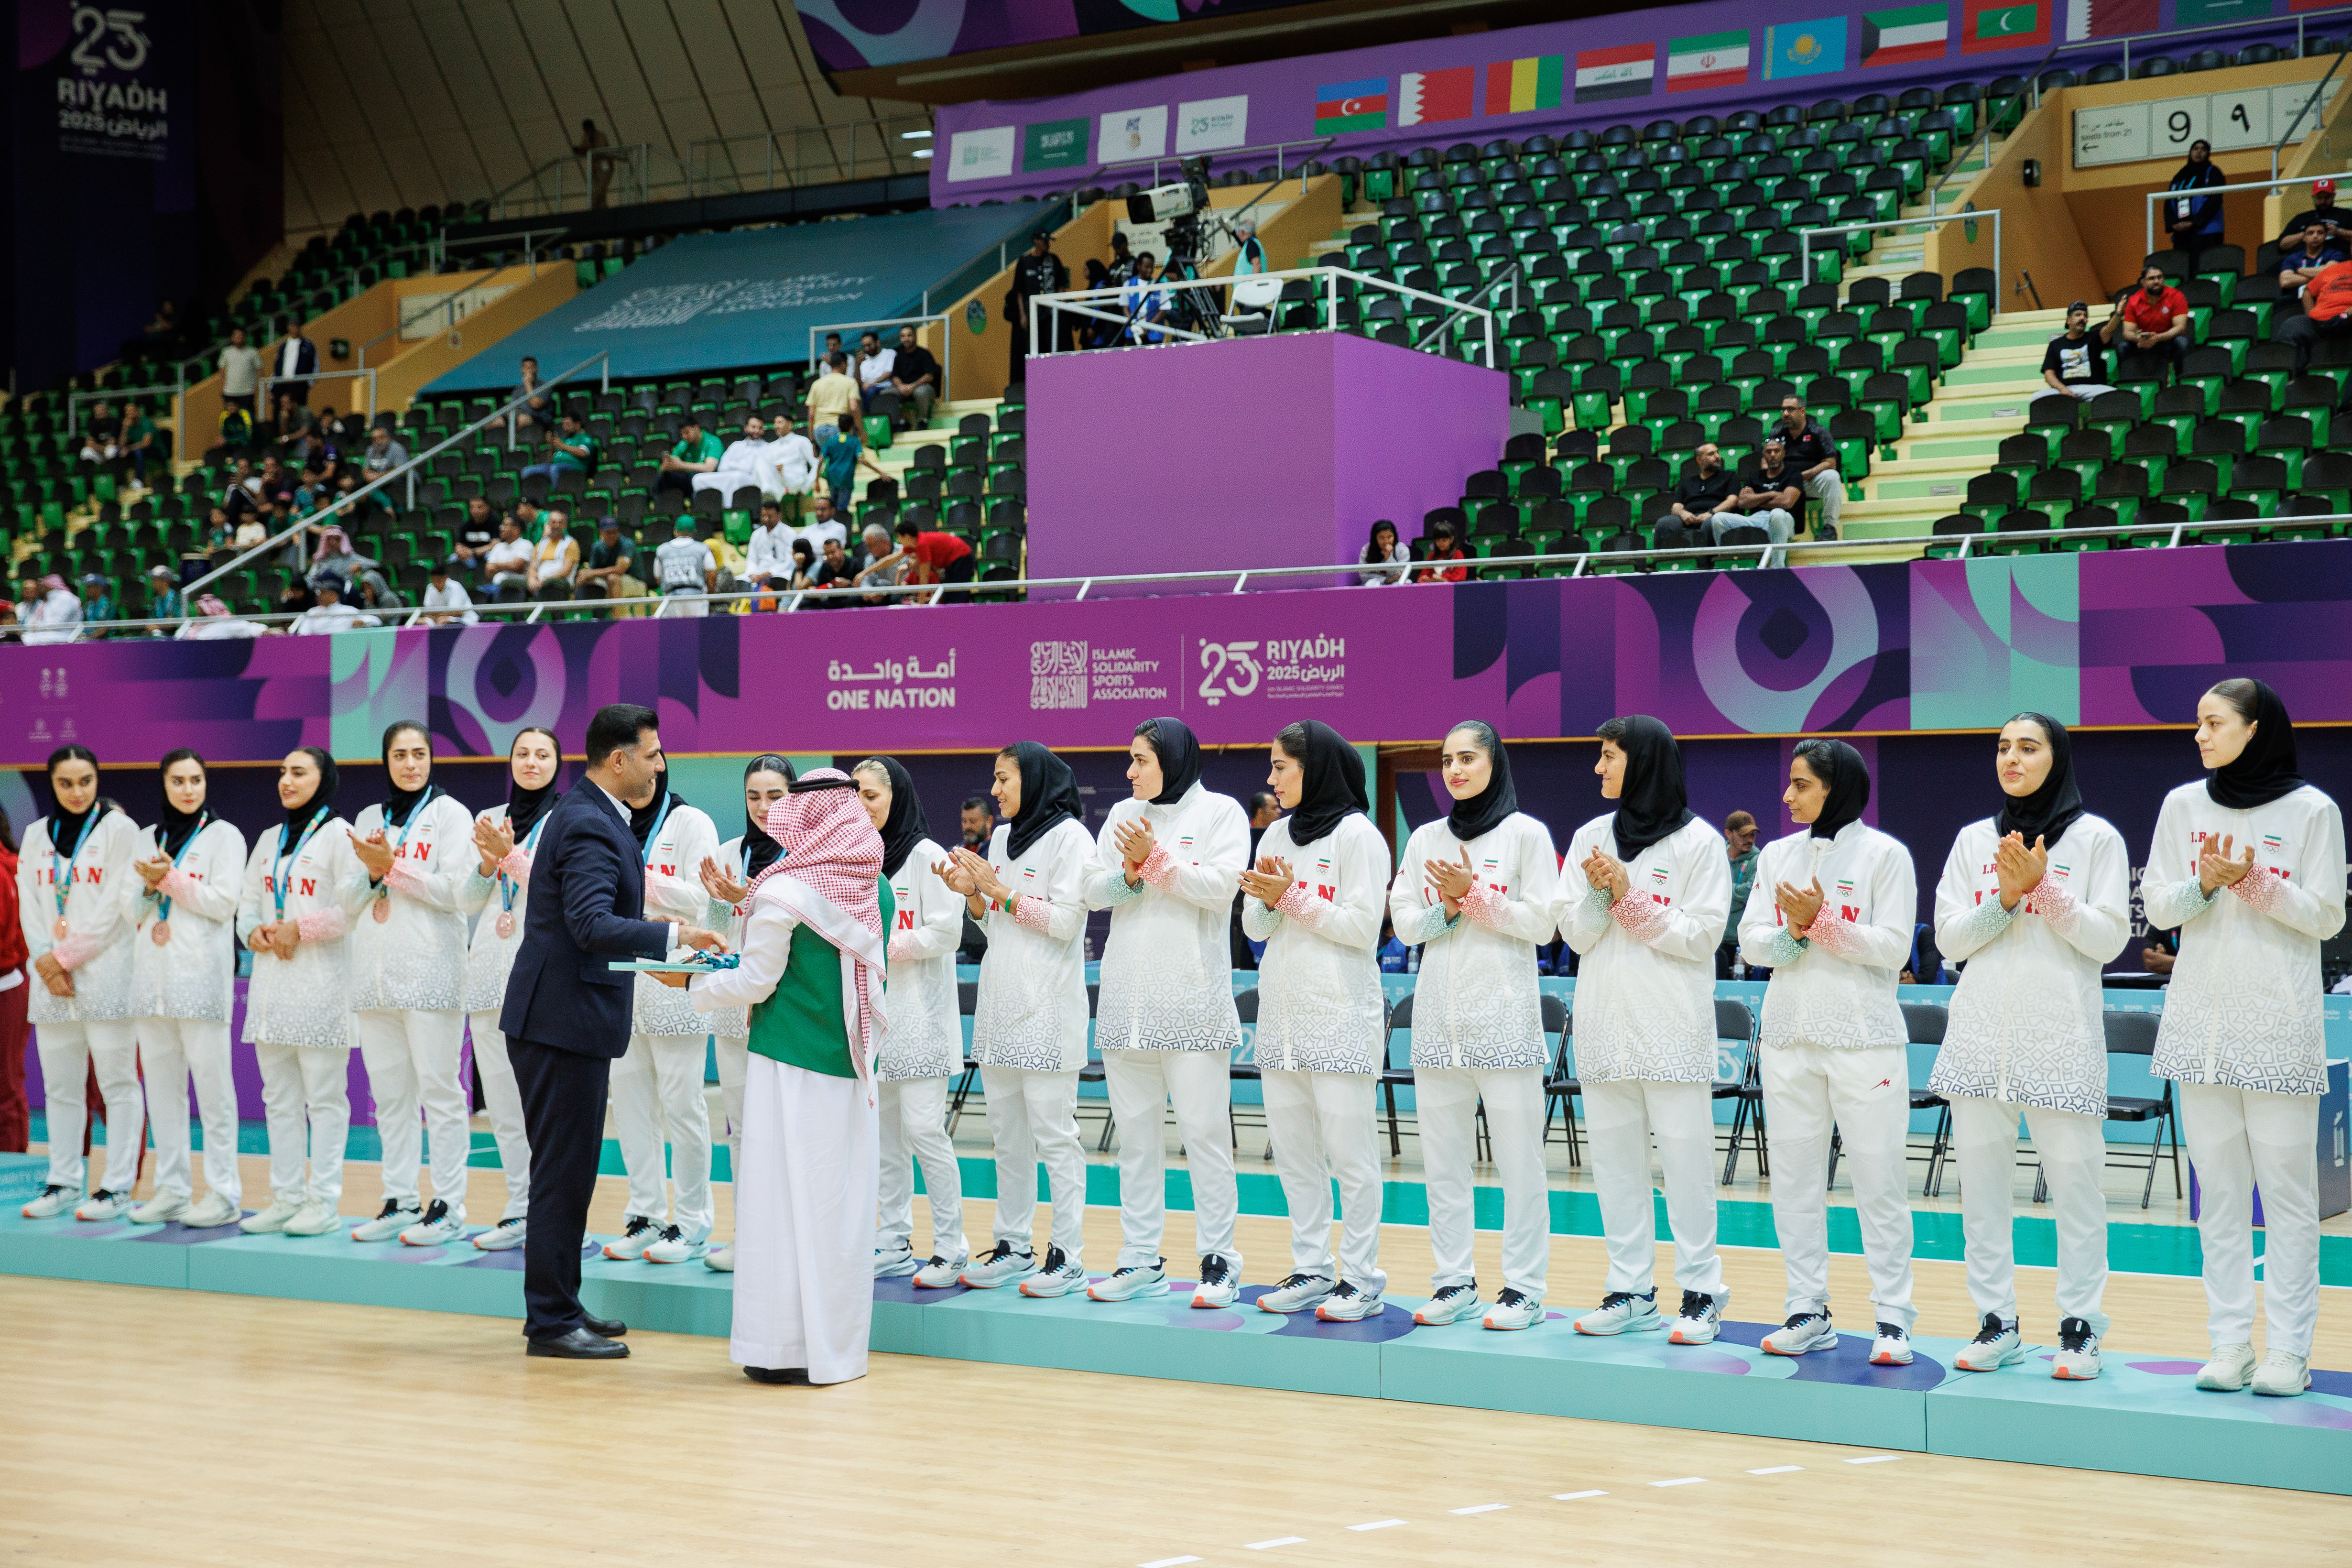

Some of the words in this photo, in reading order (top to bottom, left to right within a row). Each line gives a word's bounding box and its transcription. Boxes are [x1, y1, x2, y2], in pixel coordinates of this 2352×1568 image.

[70, 3, 152, 75] 25
[56, 77, 168, 113] RIYADH
[58, 109, 106, 132] 2025
[2168, 110, 2191, 143] 9
[1092, 647, 1136, 660] ISLAMIC
[1267, 634, 1345, 662] RIYADH
[1092, 660, 1160, 674] SOLIDARITY
[1198, 639, 1263, 706] 25
[1267, 665, 1300, 680] 2025
[1300, 664, 1345, 682] الرياض
[1092, 674, 1134, 687] SPORTS
[827, 689, 870, 710] ONE
[874, 687, 956, 708] NATION
[1092, 686, 1167, 700] ASSOCIATION
